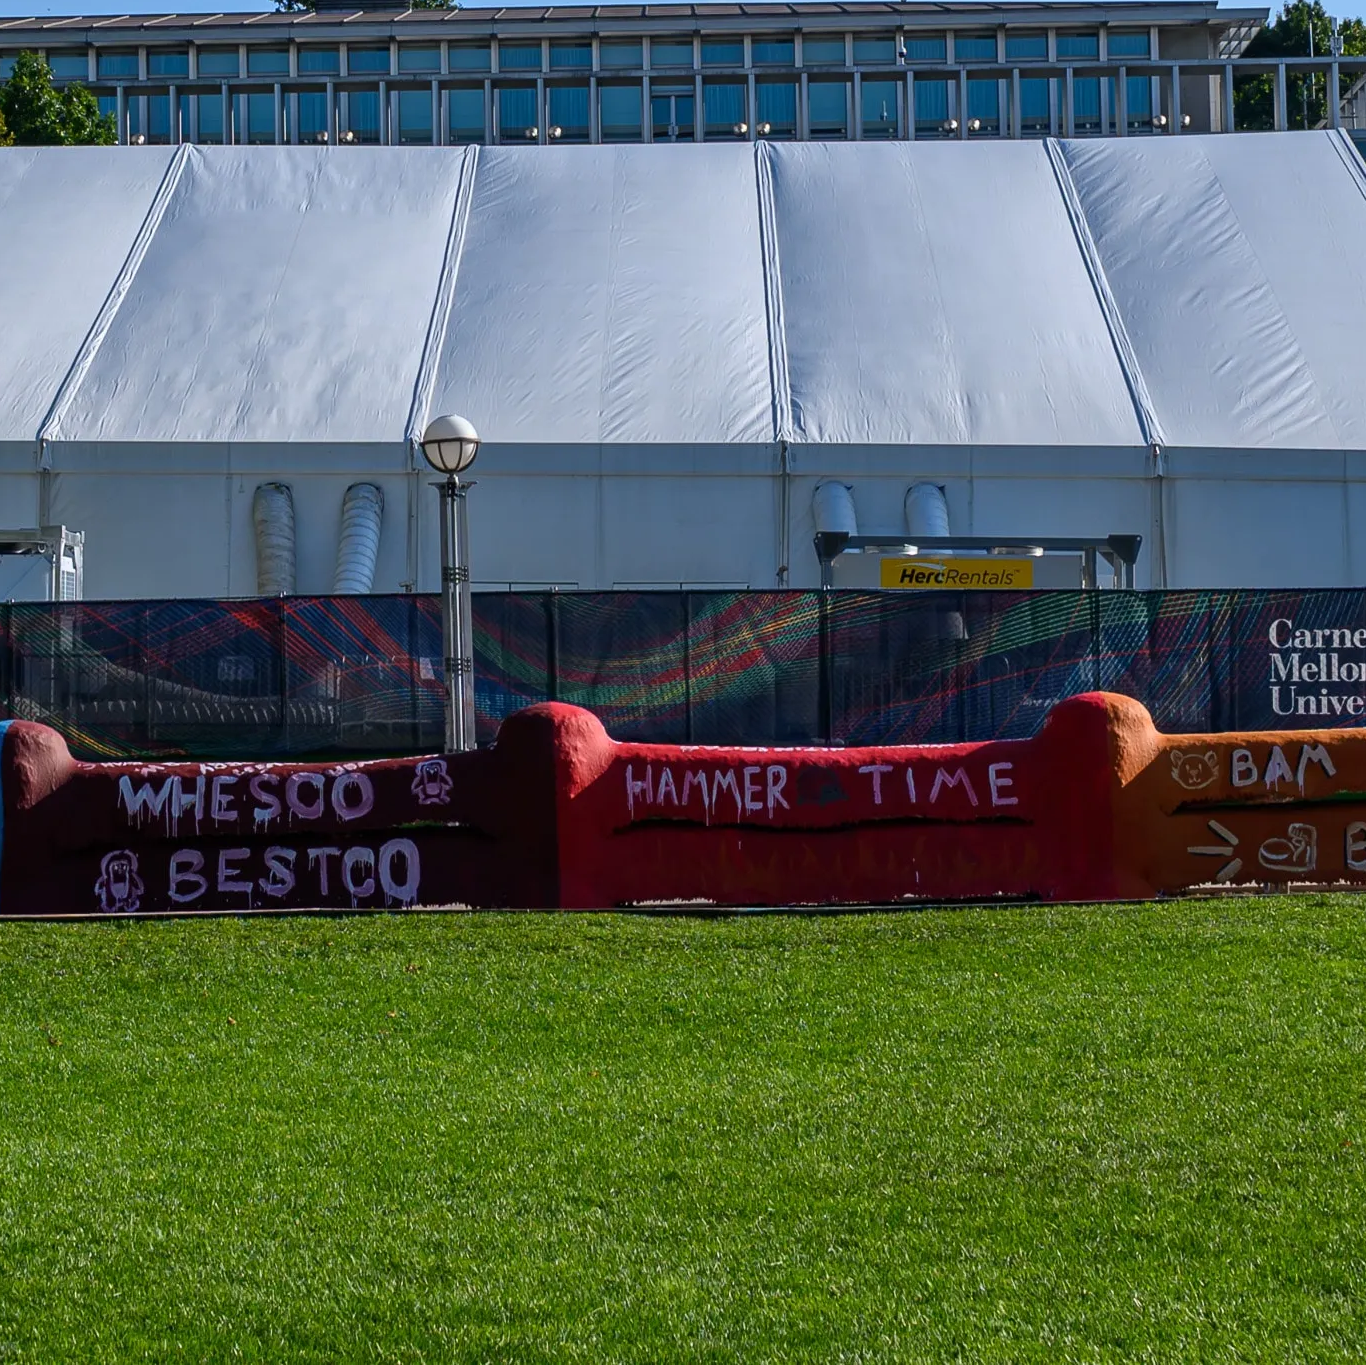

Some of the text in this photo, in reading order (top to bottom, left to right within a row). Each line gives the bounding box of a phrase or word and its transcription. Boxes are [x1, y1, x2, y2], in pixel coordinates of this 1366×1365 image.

[624, 760, 1020, 816] HAMMER TIME
[1231, 743, 1337, 789] BAM
